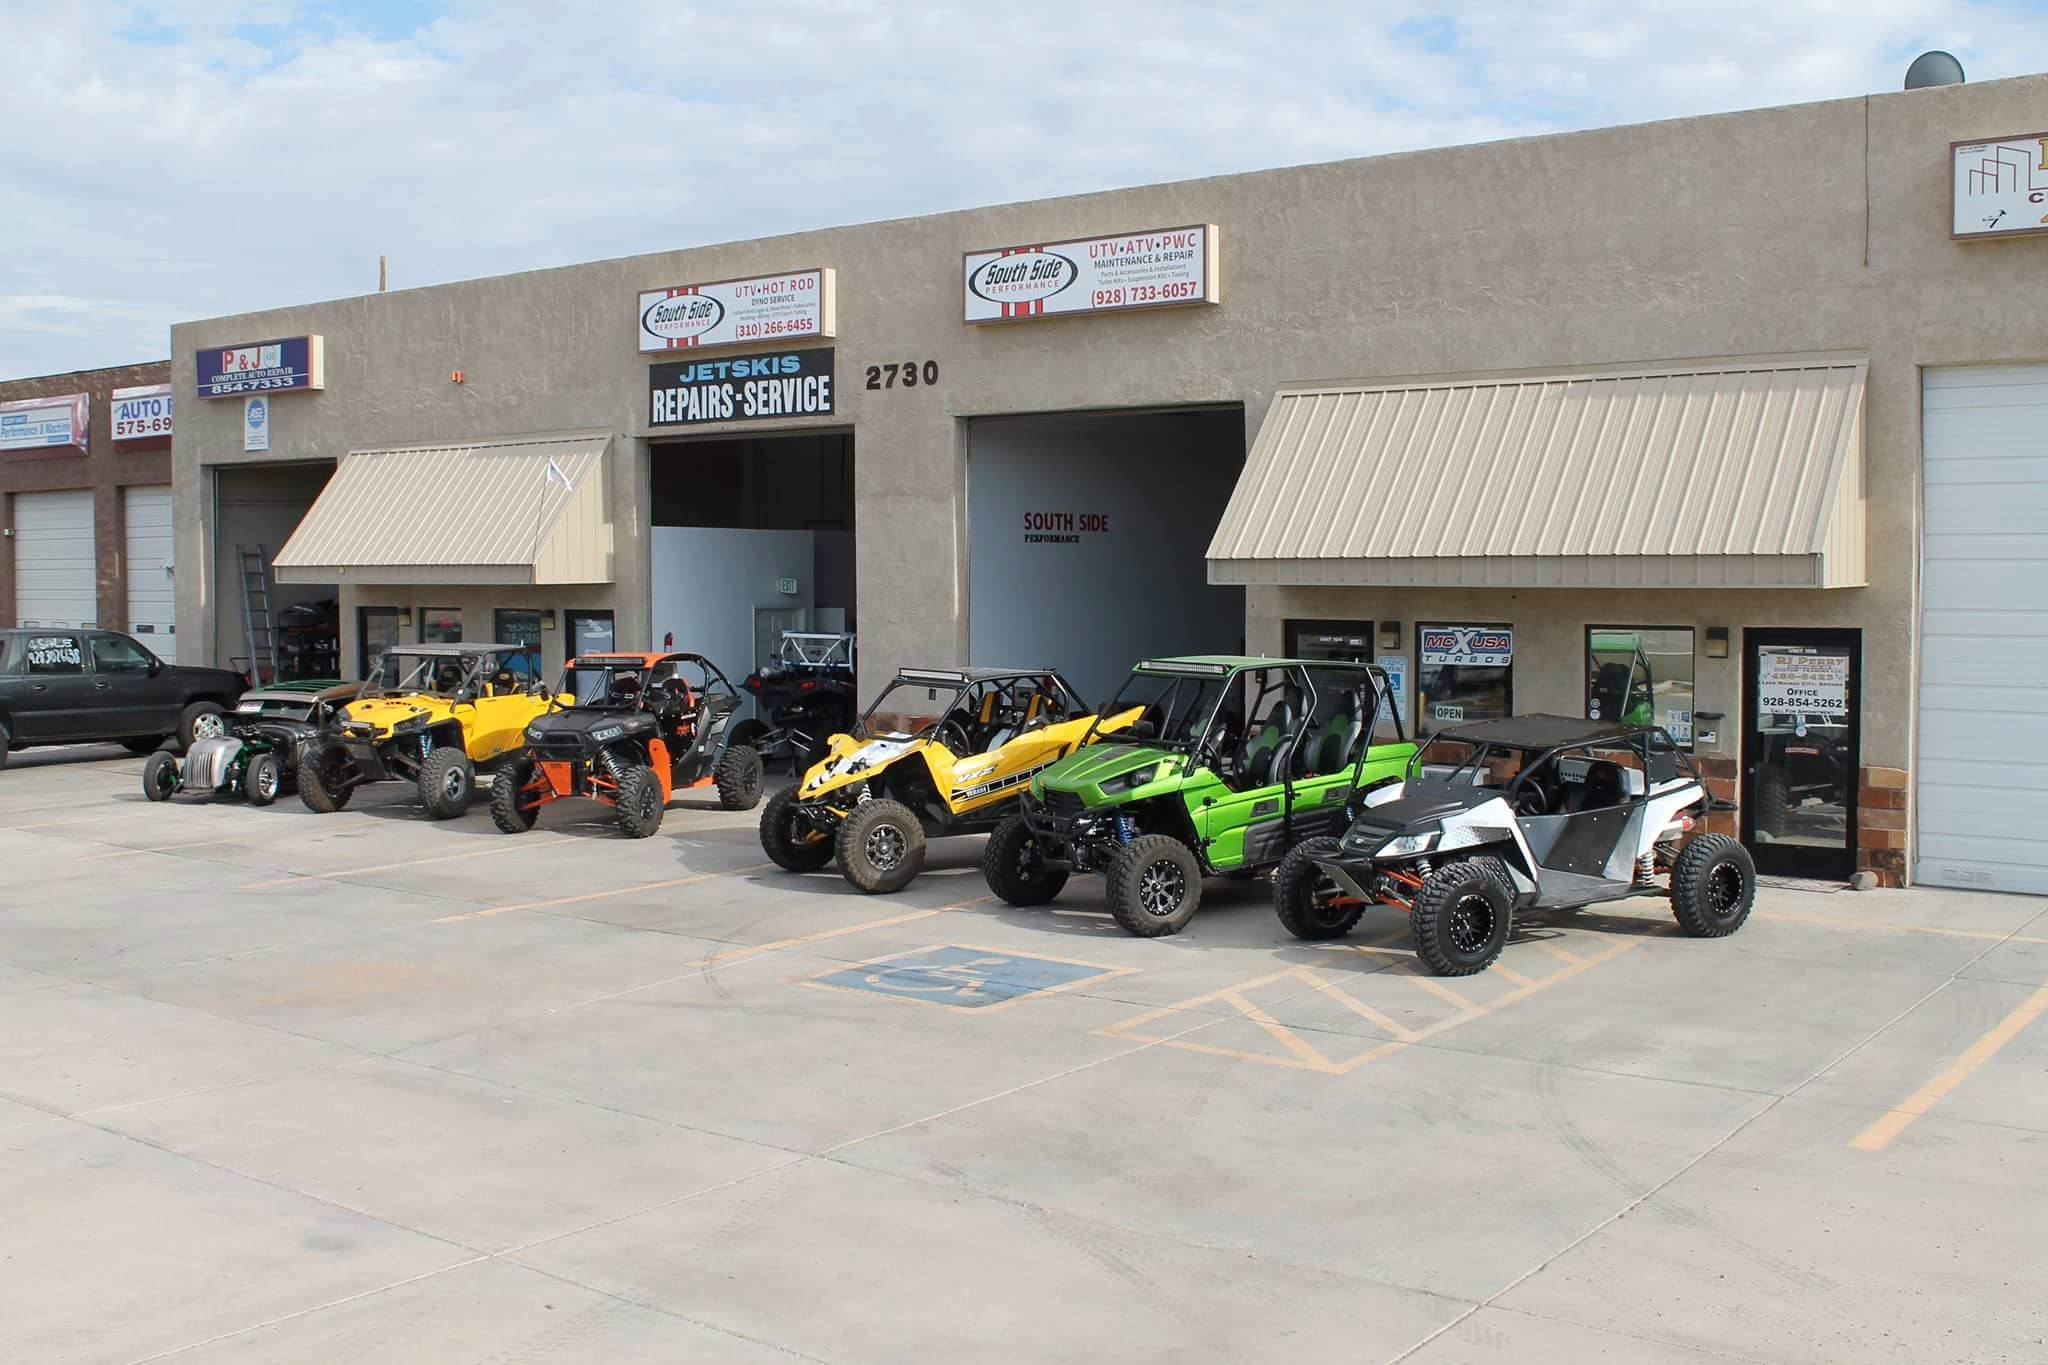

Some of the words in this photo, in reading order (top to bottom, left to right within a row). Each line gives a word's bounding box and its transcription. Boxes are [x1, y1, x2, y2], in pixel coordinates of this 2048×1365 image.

[1094, 253, 1153, 269] MAINTENANCE
[1154, 253, 1161, 263] &
[1163, 249, 1194, 260] REPAIR
[984, 262, 1028, 286] South
[1029, 258, 1063, 281] Side
[1101, 271, 1114, 279] Parts
[1120, 267, 1149, 276] Accessories
[1154, 263, 1187, 272] Installations
[1127, 274, 1157, 284] Suspension
[1158, 273, 1168, 281] Kits
[1172, 271, 1190, 279] Tuning
[790, 277, 814, 292] ROD
[985, 280, 1060, 294] PERFORMANCE
[751, 297, 769, 306] DYNO
[769, 293, 795, 304] SERVICE
[1092, 286, 1127, 309] (928)
[1131, 281, 1198, 301] 733-6057
[654, 303, 688, 324] South
[688, 301, 713, 320] Side
[654, 319, 711, 331] PERFORMANCE
[735, 322, 761, 340] (310)
[764, 318, 813, 335] 266-6455
[223, 351, 234, 372] P
[239, 354, 249, 371] &
[251, 346, 261, 369] J
[211, 373, 247, 383] COMPLETE
[247, 370, 267, 380] AUTO
[267, 366, 294, 377] REPAIR
[679, 355, 801, 383] JETSKIS
[866, 360, 939, 391] 2730
[211, 377, 295, 394] 854-7333
[652, 375, 831, 423] REPAIRS-SERVICE
[120, 399, 162, 420] AUTO
[116, 416, 172, 436] 575-69
[1024, 512, 1074, 531] SOUTH
[1079, 513, 1109, 532] SIDE
[1024, 533, 1080, 544] PERFORMANCE
[38, 638, 73, 650] SALE
[1424, 655, 1510, 664] TURBOS
[1775, 656, 1793, 665] RJ
[1762, 697, 1843, 708] 928-854-5262
[1436, 706, 1462, 719] OPEN
